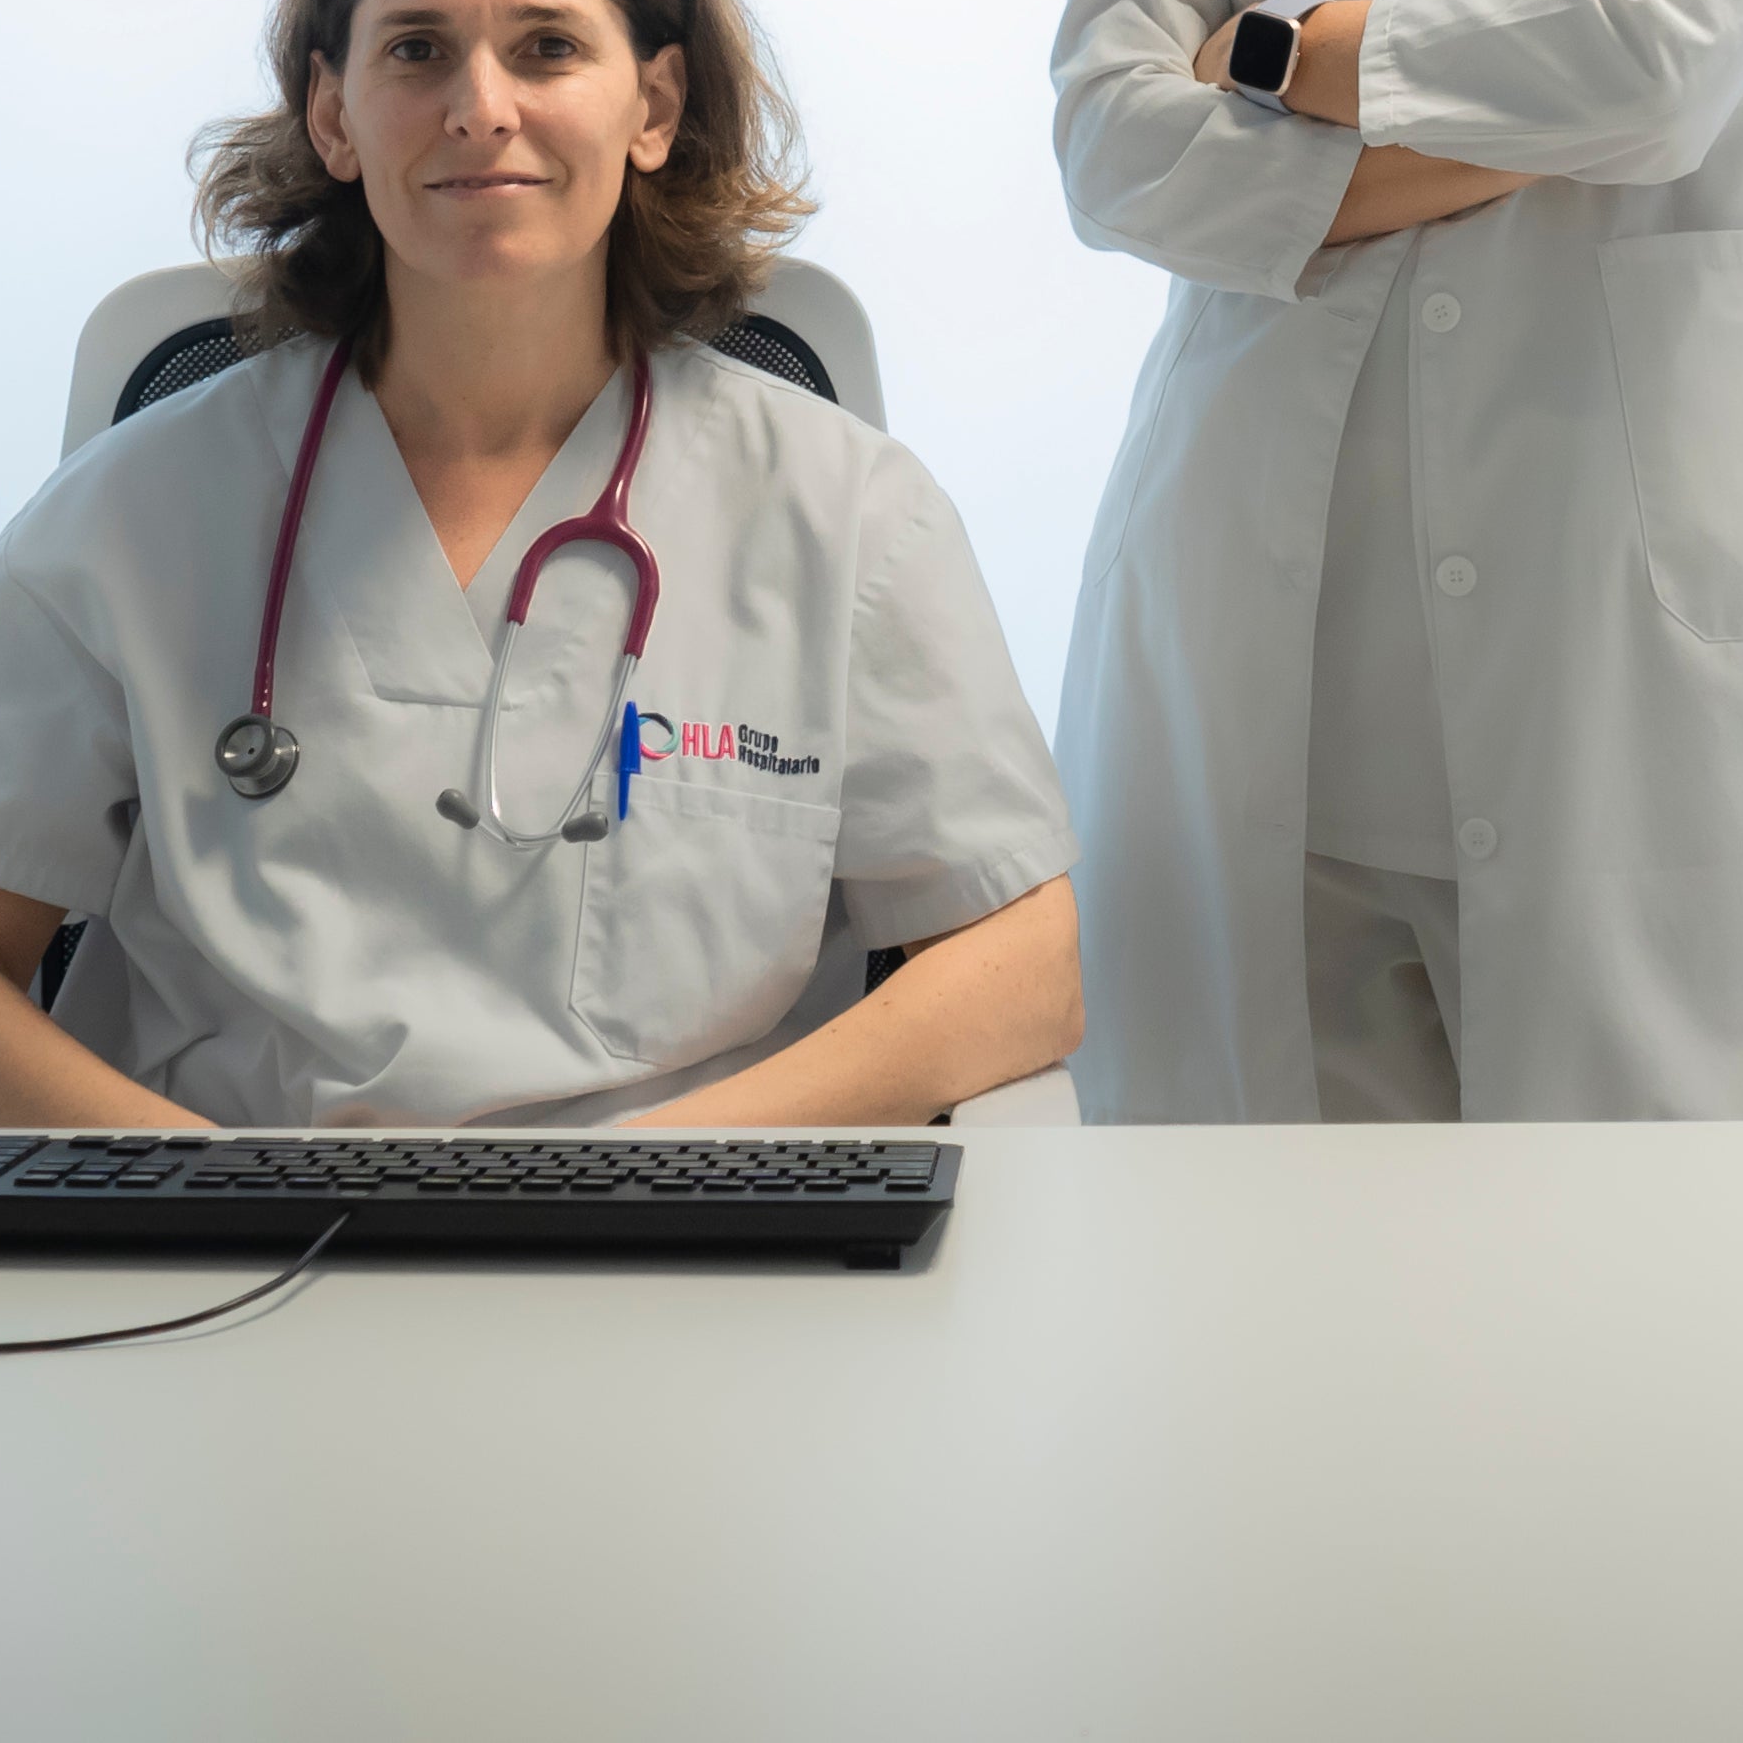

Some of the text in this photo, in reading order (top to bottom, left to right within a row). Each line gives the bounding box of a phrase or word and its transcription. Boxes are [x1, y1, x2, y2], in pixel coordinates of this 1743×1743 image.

[682, 722, 736, 760] HLA
[738, 723, 778, 753] Grupo
[738, 744, 820, 775] Hospitalario
